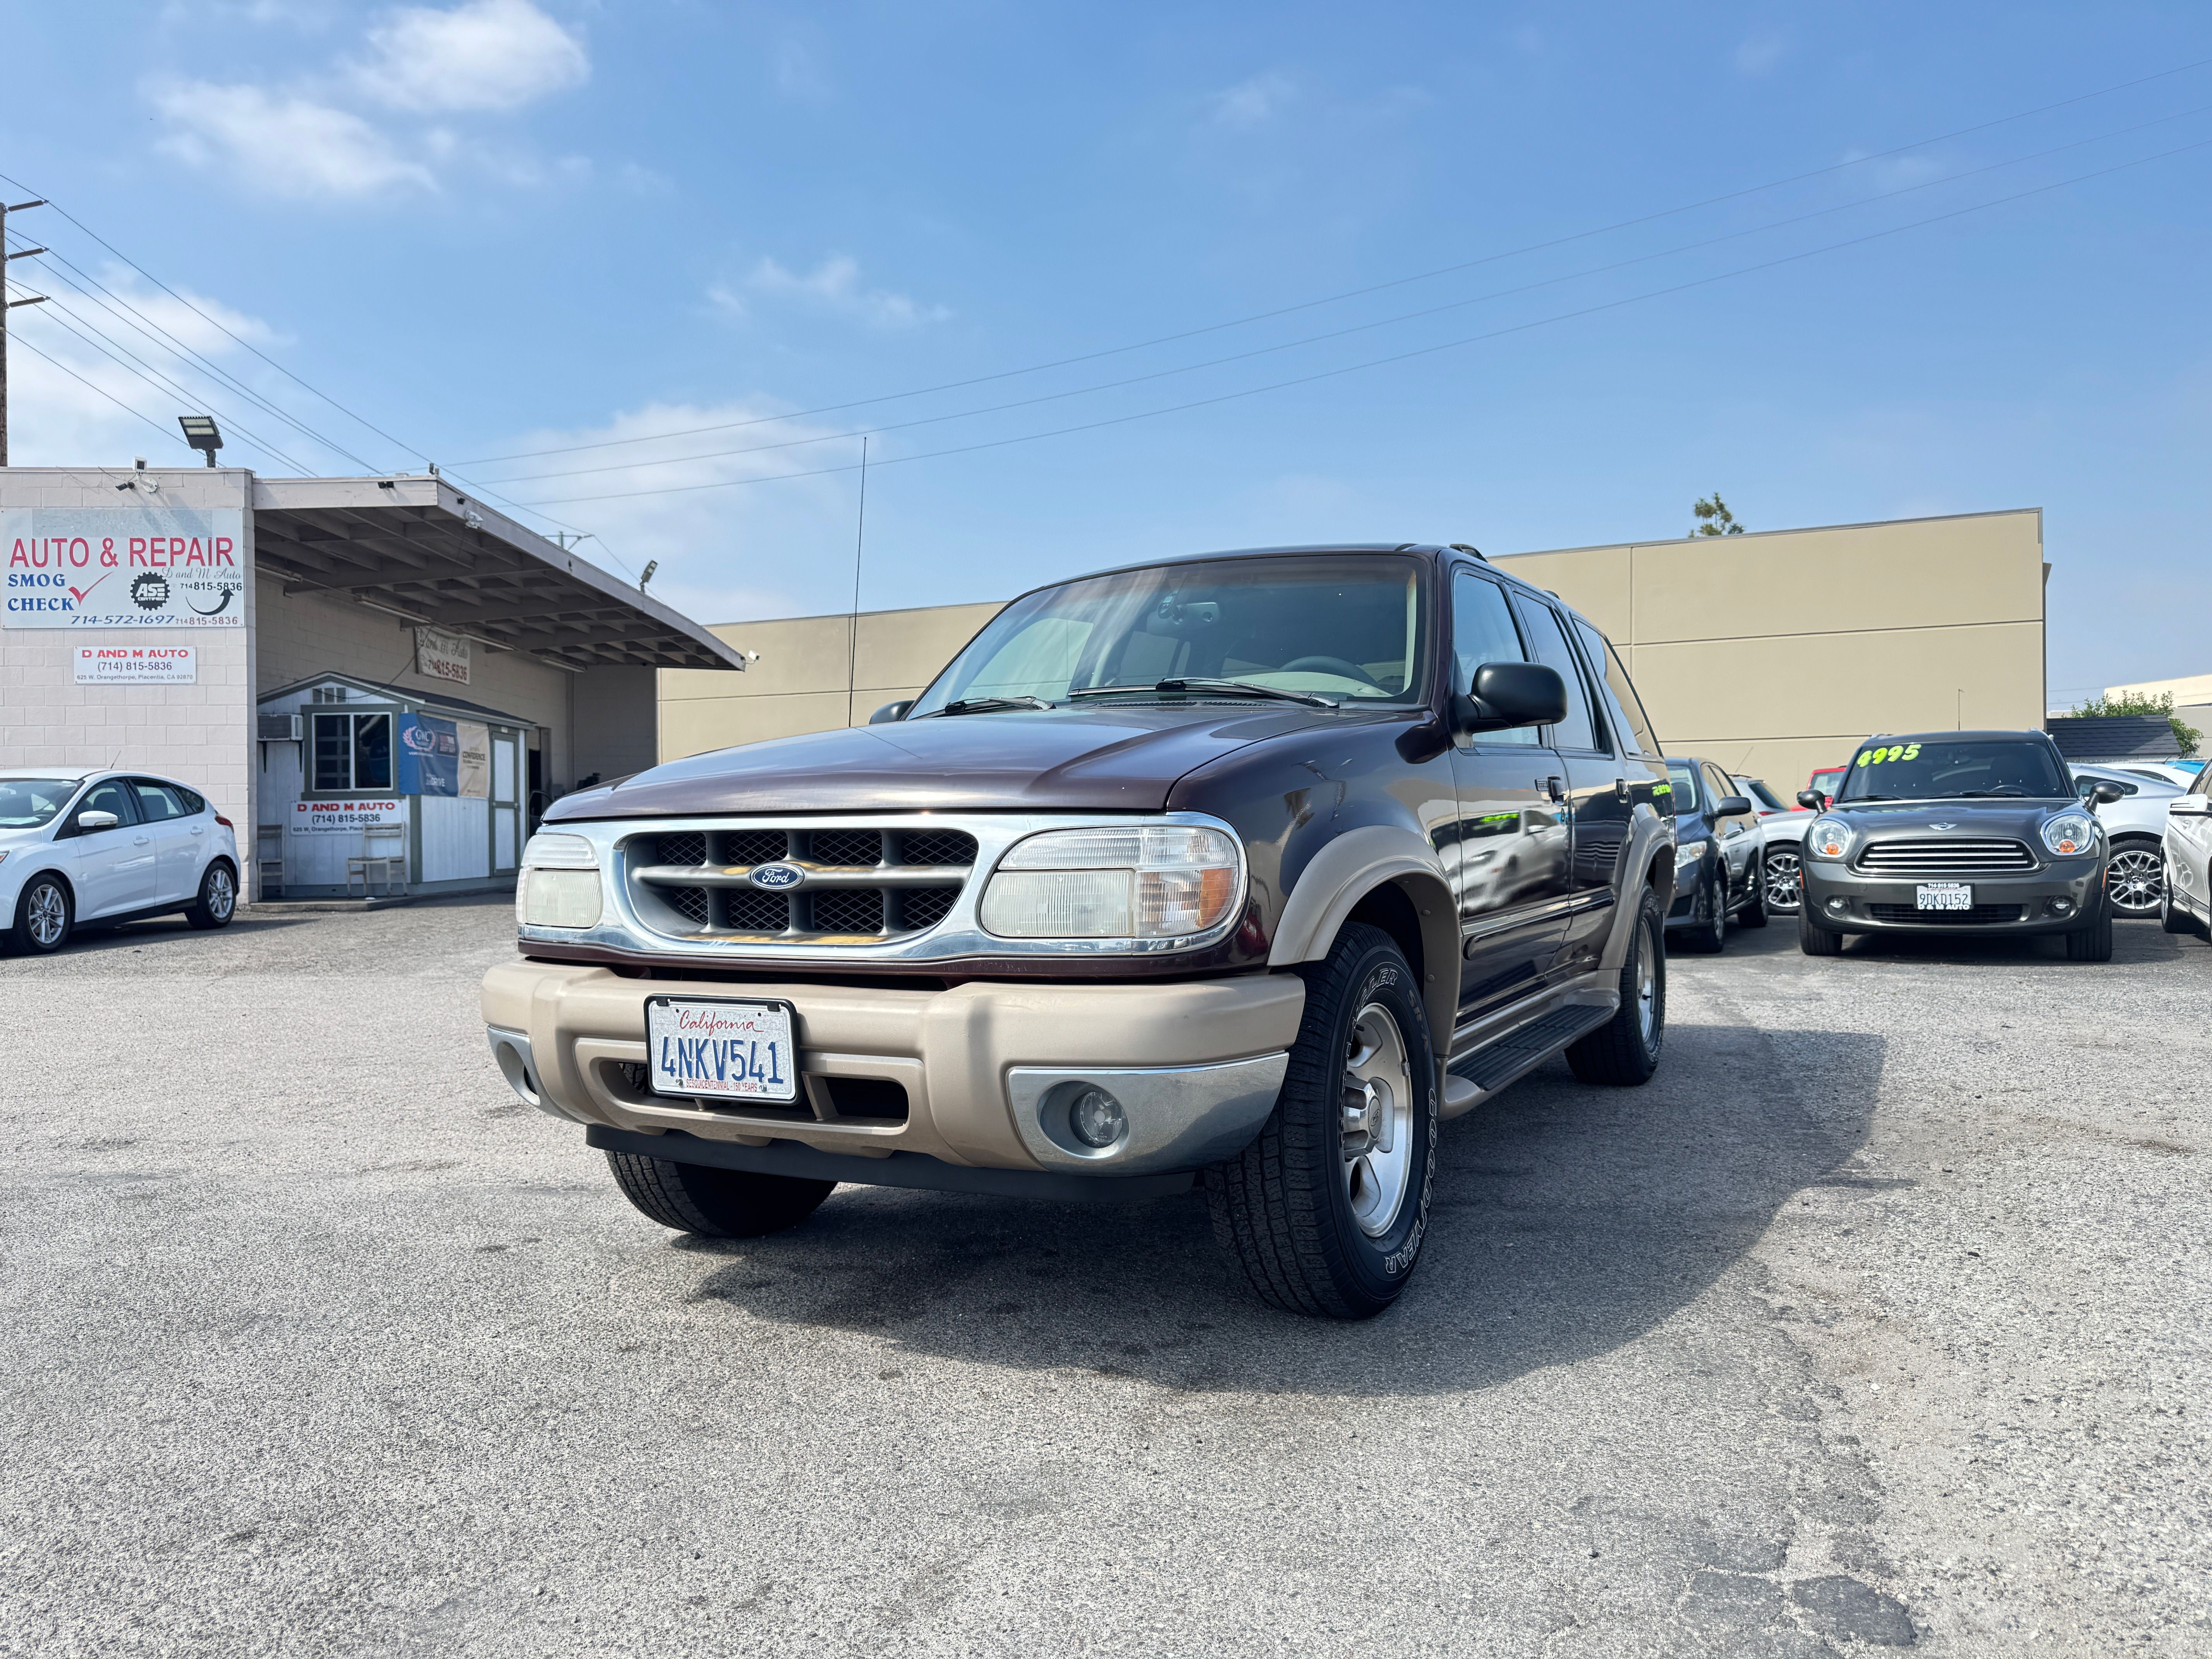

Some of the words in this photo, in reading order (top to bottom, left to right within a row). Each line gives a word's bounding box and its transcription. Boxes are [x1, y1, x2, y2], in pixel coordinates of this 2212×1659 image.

[10, 538, 89, 567] AUTO
[100, 538, 118, 567] &
[130, 537, 235, 567] REPAIR
[161, 566, 173, 578] D
[176, 568, 193, 579] and
[196, 568, 211, 579] M
[214, 568, 242, 579] Auto
[8, 574, 65, 587] SMOG
[136, 583, 165, 597] ASE
[8, 598, 74, 611] CHECK
[71, 615, 175, 624] 714-572-1697
[148, 649, 188, 658] AUTO
[98, 661, 123, 672] (714)
[126, 662, 172, 670] 815-5836
[312, 804, 339, 812] AND
[358, 802, 395, 811] AUTO
[312, 814, 335, 824] (714)
[338, 814, 380, 823] 815-5836
[762, 868, 790, 883] Ford
[1920, 893, 1968, 905] 9DKD152
[679, 1010, 764, 1036] California
[661, 1035, 783, 1084] 4NKV541
[686, 1079, 729, 1090] SESQUICENTENNIAL
[742, 1083, 757, 1092] YEARS
[1384, 1088, 1437, 1273] GOODYEAR
